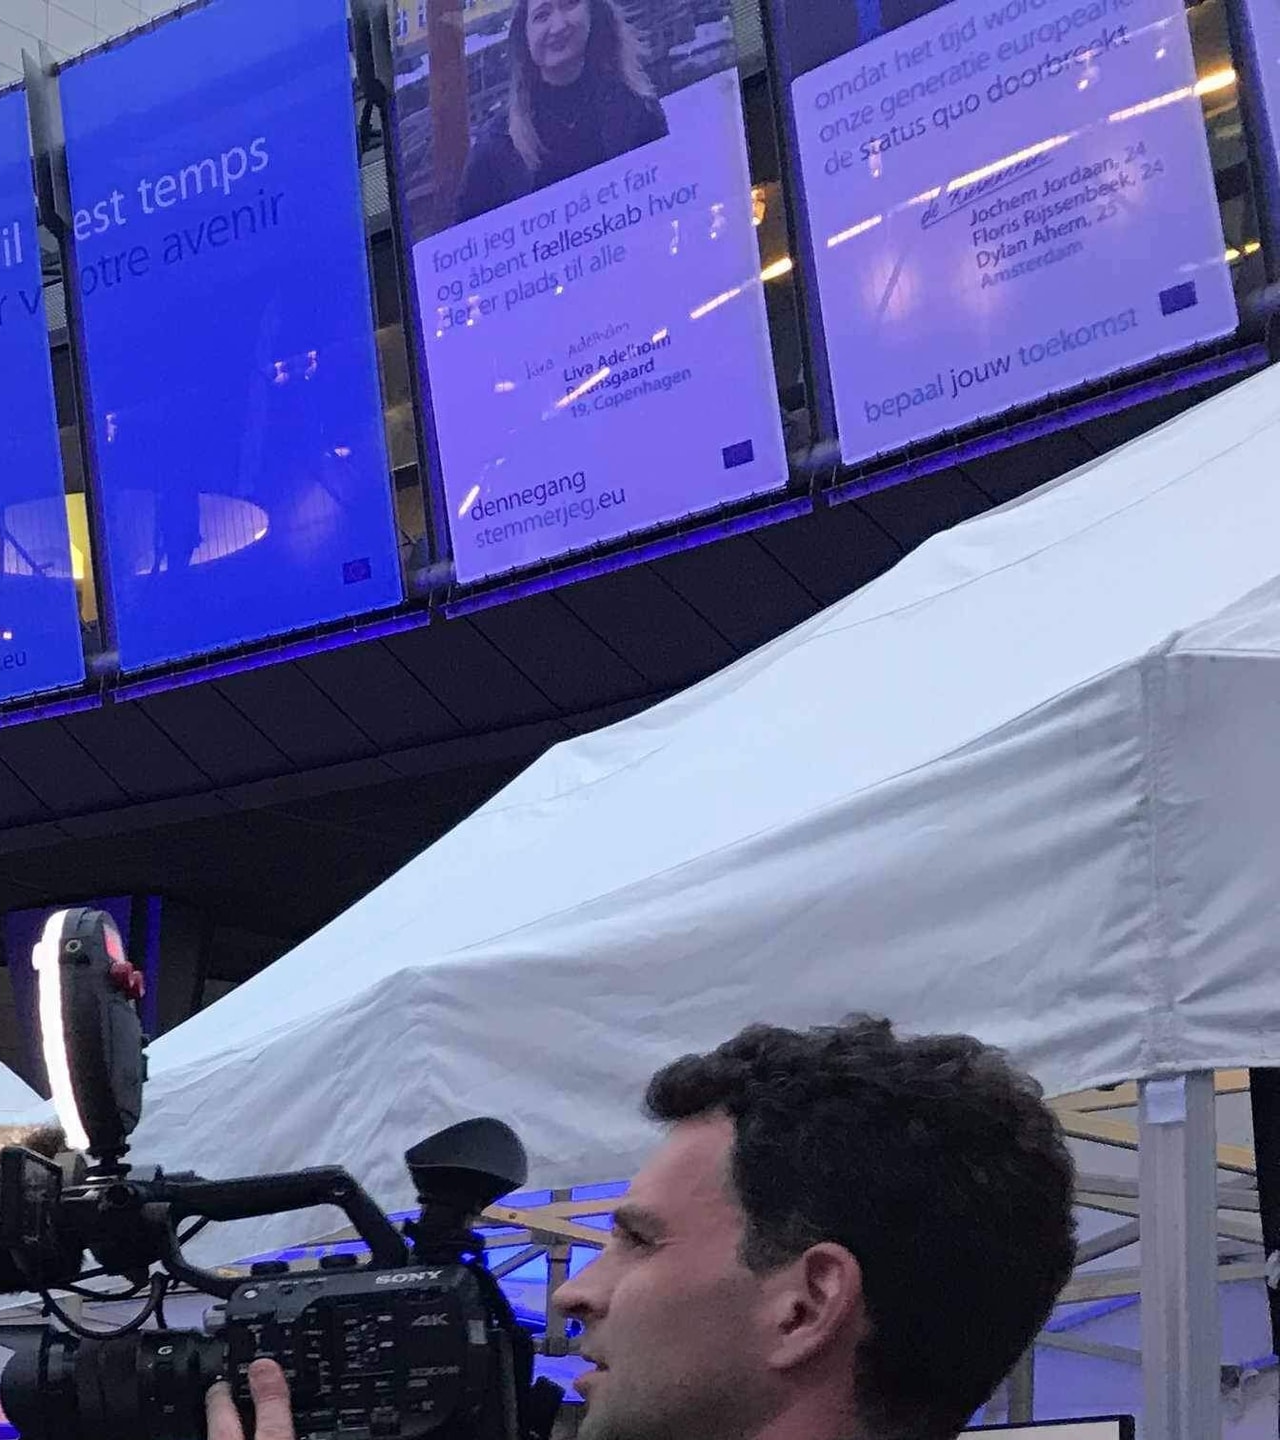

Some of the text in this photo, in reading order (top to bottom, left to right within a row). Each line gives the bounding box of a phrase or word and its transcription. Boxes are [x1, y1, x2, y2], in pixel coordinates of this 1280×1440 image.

[815, 16, 977, 111] omdat het tijd
[819, 56, 991, 143] onze generatie
[824, 150, 853, 176] de
[859, 114, 927, 160] status
[932, 93, 980, 130] quo
[73, 136, 269, 241] est temps
[432, 164, 660, 273] fordi jeg tror på et fair
[969, 188, 1038, 226] Jochem
[1042, 157, 1120, 196] Jordaan,
[163, 189, 284, 265] avenir
[437, 182, 700, 302] og åbent fællesskab hvor
[973, 217, 1020, 247] Floris
[976, 239, 1027, 269] Dylan
[479, 295, 498, 316] er
[503, 271, 559, 312] plads
[564, 259, 584, 284] til
[589, 242, 627, 273] alle
[981, 240, 1084, 289] Amsterdam
[563, 362, 593, 382] Liva
[571, 367, 693, 419] 19, Copenhagen
[864, 307, 1138, 423] bepaal jouw toekomst
[471, 470, 586, 521] dennegang
[476, 488, 626, 548] stemmerjeg.eu
[375, 1269, 443, 1285] SONY
[411, 1312, 450, 1327] 4K
